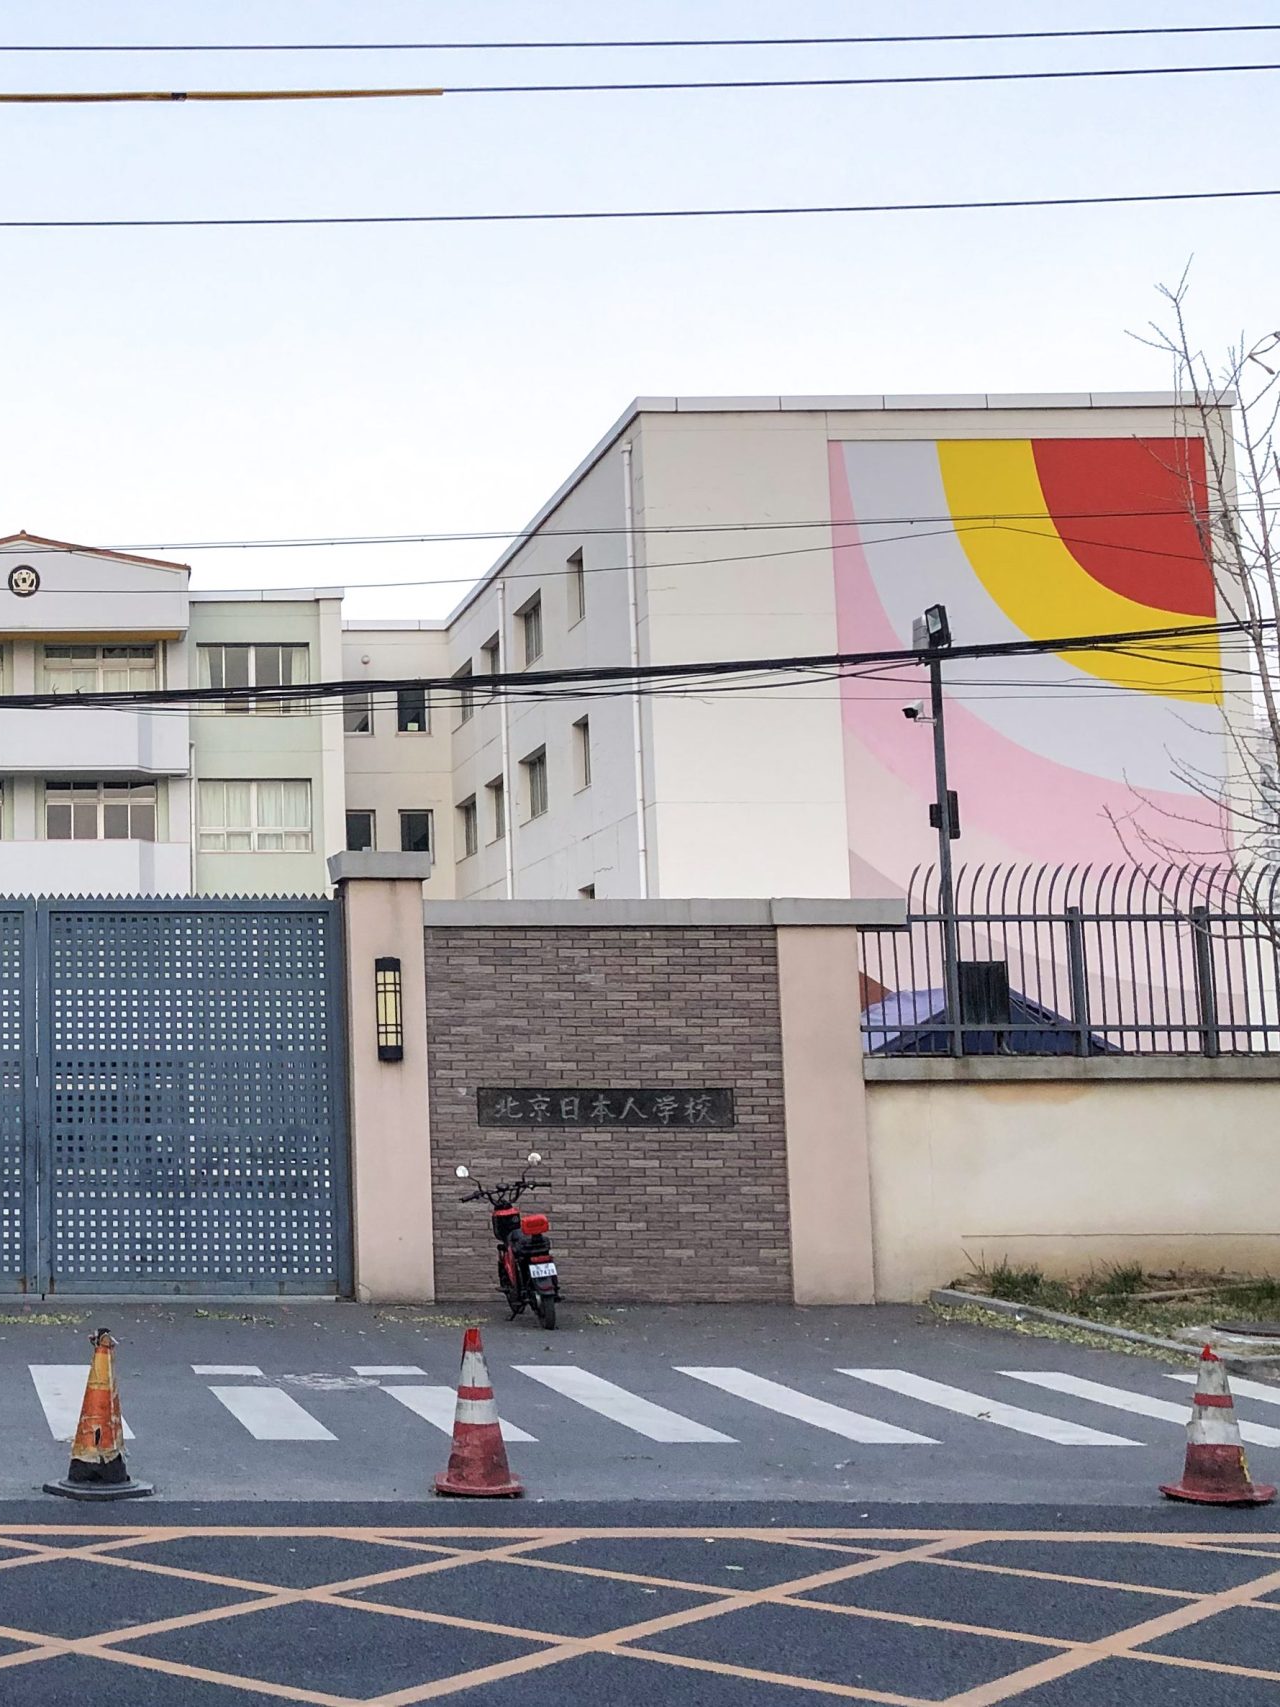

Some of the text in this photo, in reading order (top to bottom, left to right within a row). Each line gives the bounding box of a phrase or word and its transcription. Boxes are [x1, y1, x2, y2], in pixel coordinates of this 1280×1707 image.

[494, 1093, 716, 1124] 北京日本人学校
